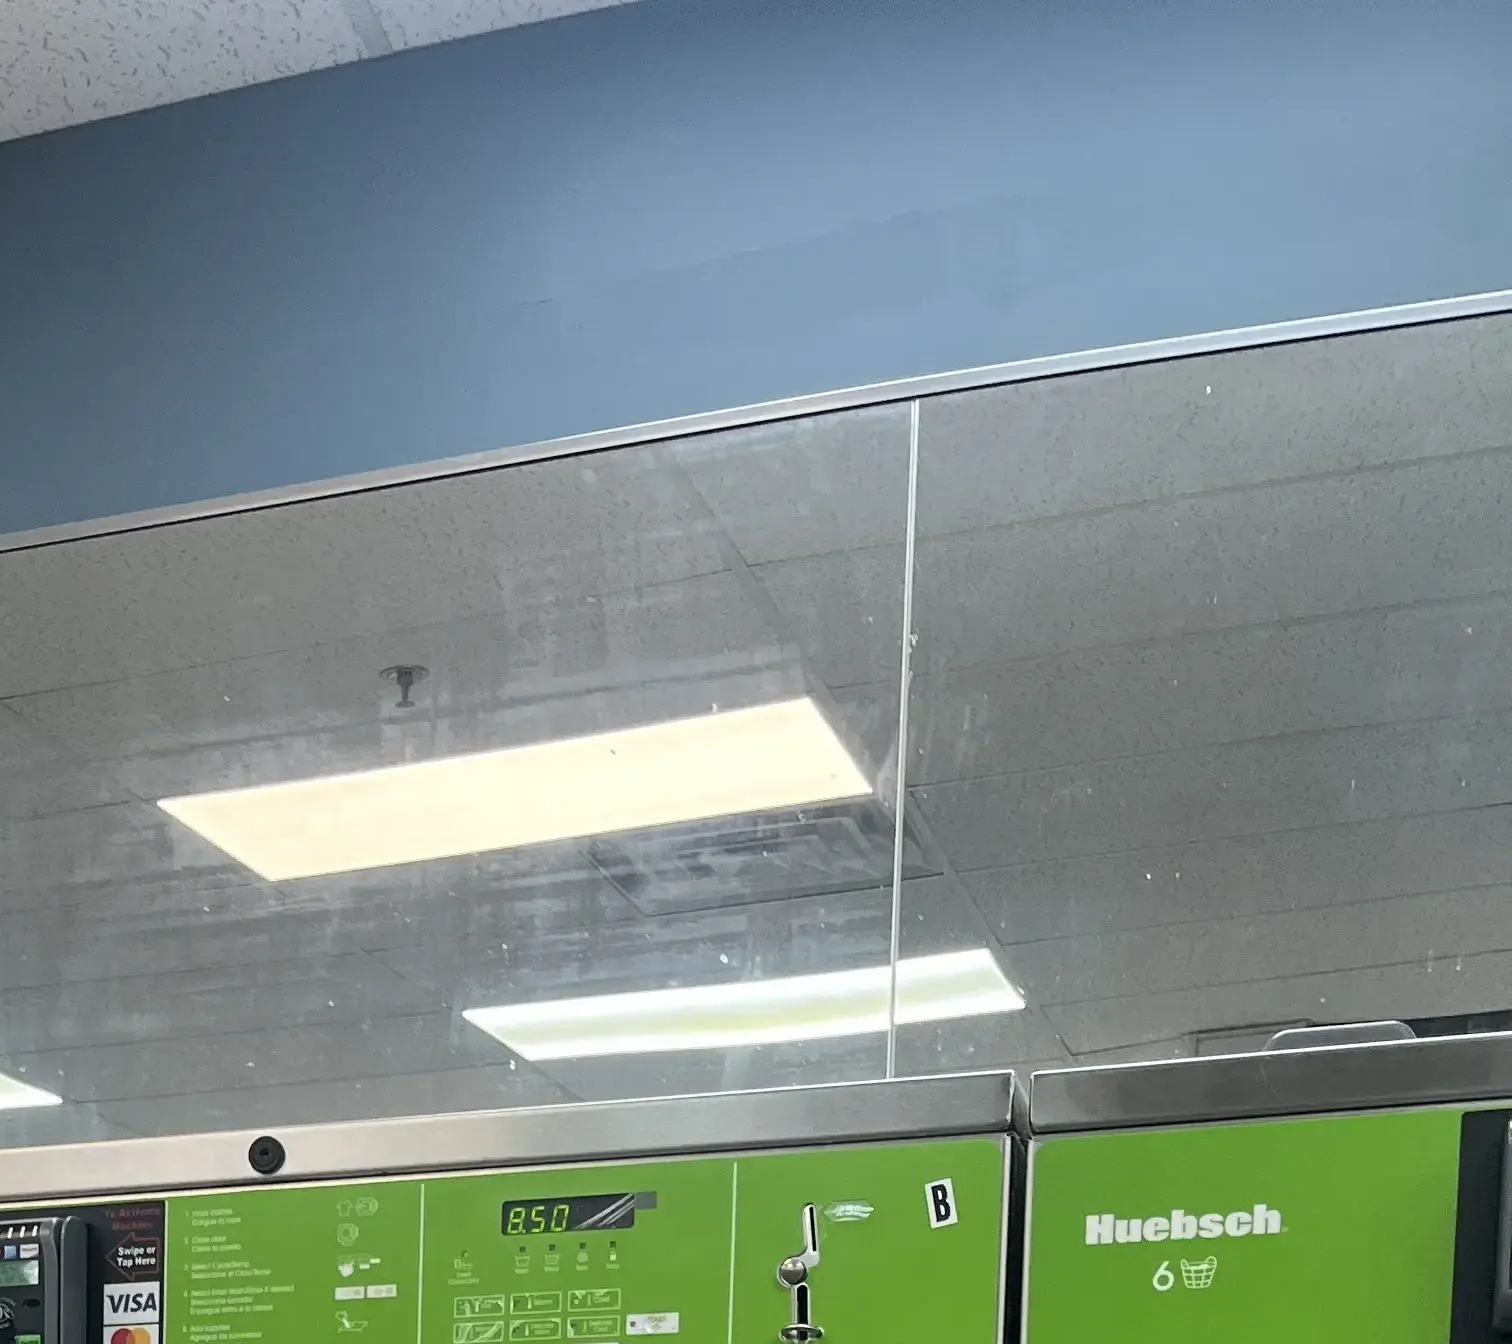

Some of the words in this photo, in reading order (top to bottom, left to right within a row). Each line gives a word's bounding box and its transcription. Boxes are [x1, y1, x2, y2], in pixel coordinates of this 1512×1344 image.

[931, 1183, 951, 1222] B
[507, 1204, 570, 1234] 8.50
[1085, 1204, 1282, 1245] Huebsch
[117, 1258, 133, 1269] Tap
[135, 1256, 156, 1266] Here
[118, 1246, 144, 1258] Swipe
[1152, 1260, 1175, 1292] 6
[106, 1293, 157, 1314] VISA
